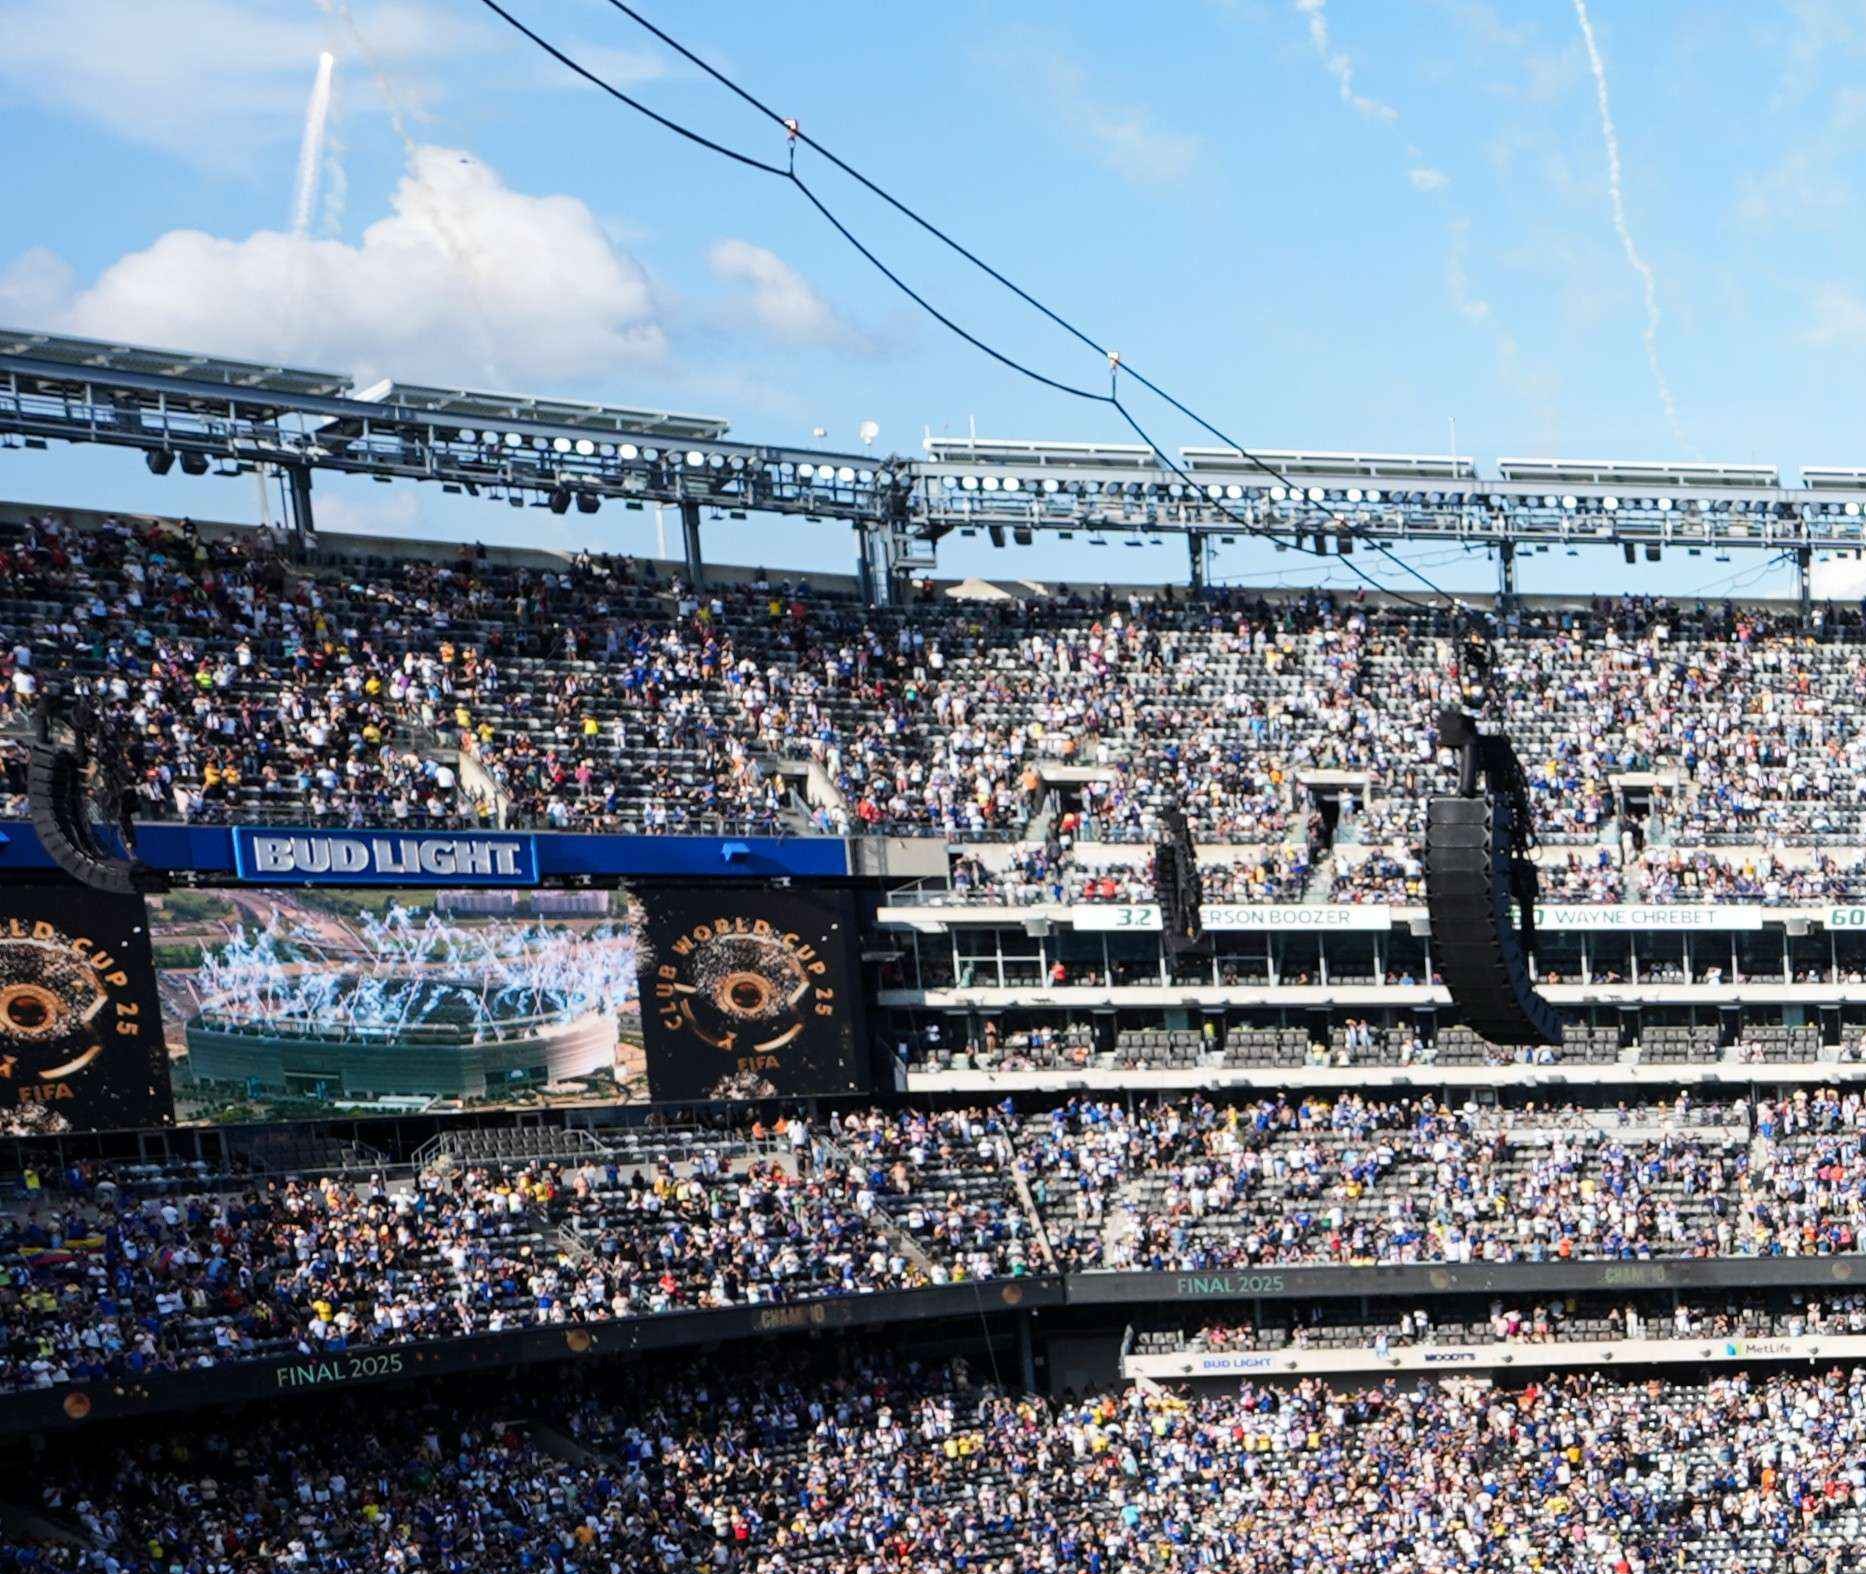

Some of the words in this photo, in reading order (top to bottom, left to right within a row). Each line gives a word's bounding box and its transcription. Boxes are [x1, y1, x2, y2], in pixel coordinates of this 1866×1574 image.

[254, 837, 369, 873] BUD
[373, 838, 521, 875] LIGHT
[1269, 910, 1350, 925] BOOZER
[1555, 910, 1627, 924] WAYNE
[1631, 910, 1717, 924] CHREBET
[1831, 909, 1865, 926] 60
[656, 964, 683, 1030] CLUB
[671, 917, 771, 955] WORLD
[782, 932, 827, 975] CUP
[815, 988, 834, 1016] 25
[71, 937, 128, 987] CUP
[116, 1002, 141, 1036] 25
[18, 1082, 75, 1103] FIFA
[1177, 1277, 1235, 1294] FINAL
[1238, 1275, 1285, 1292] 2025
[1745, 1342, 1793, 1354] MetLife
[277, 1361, 346, 1388] FINAL
[349, 1353, 403, 1378] 2025
[1203, 1358, 1231, 1369] BUD
[1233, 1357, 1271, 1368] LIGHT
